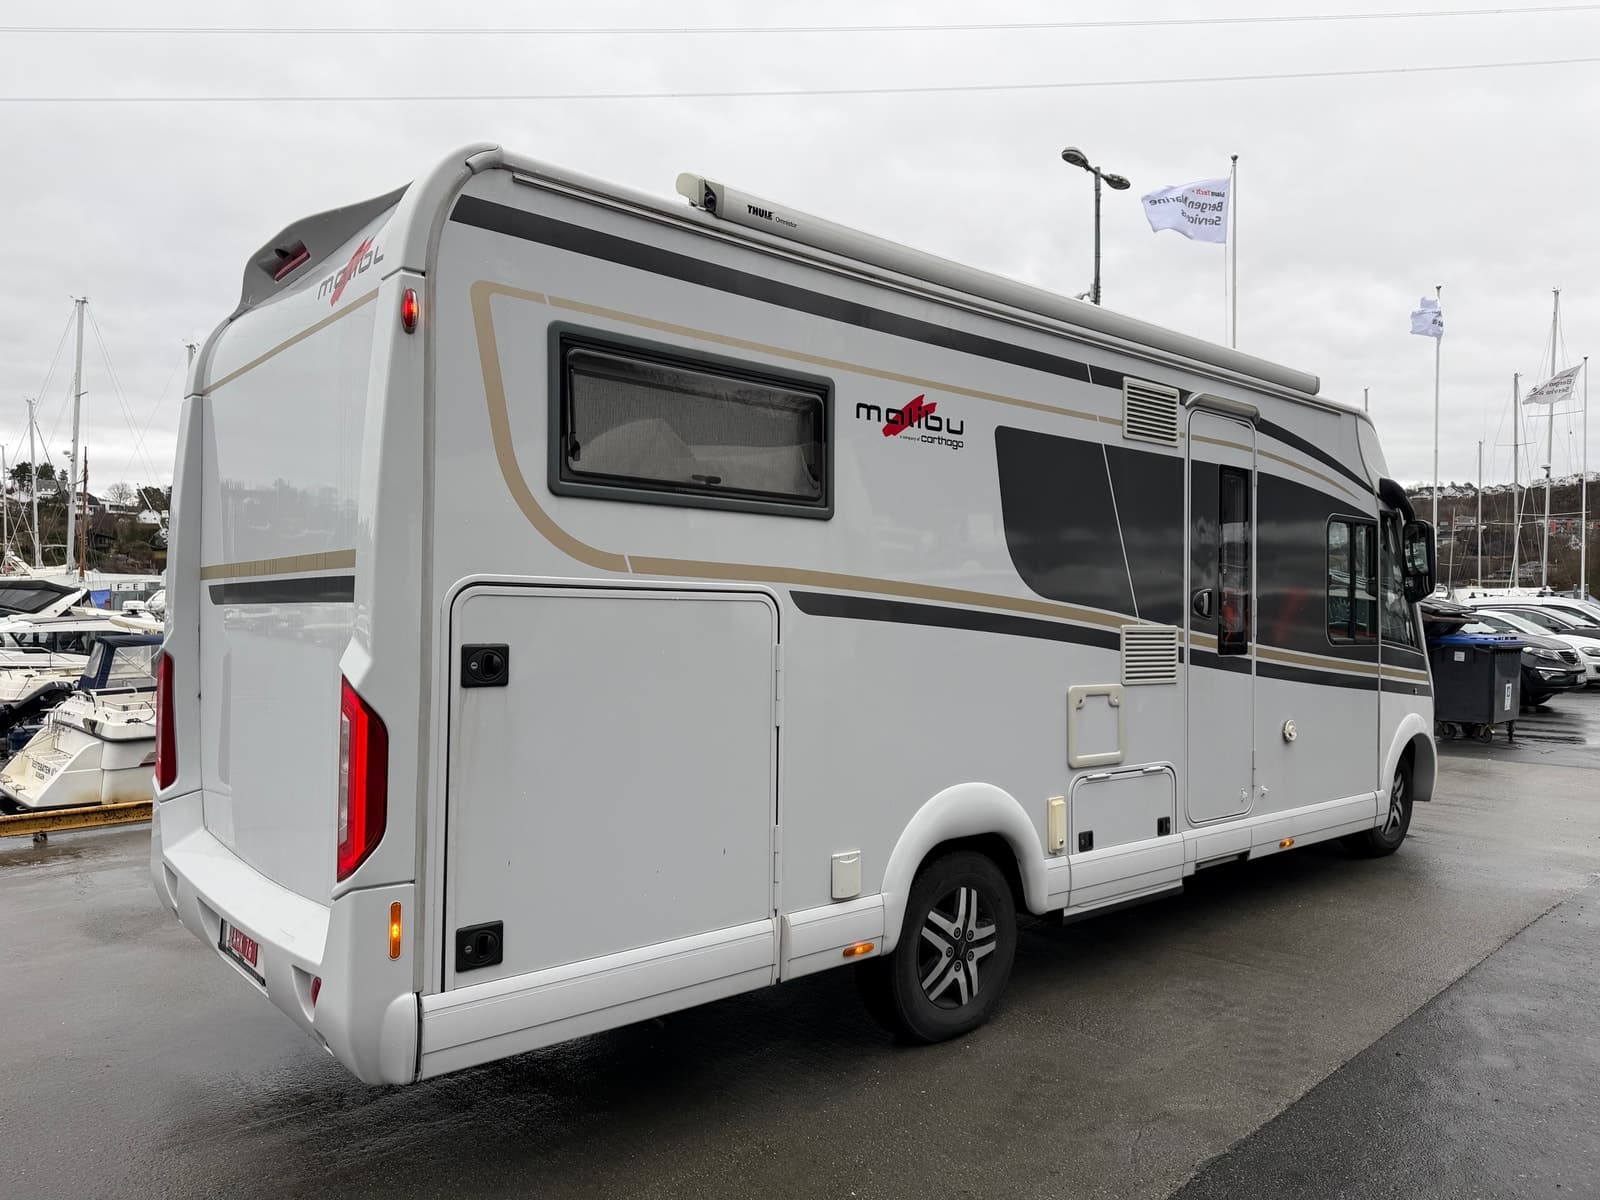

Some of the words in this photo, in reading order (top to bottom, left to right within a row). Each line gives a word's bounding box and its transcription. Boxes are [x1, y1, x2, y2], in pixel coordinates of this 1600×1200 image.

[747, 205, 774, 221] THULE
[856, 402, 964, 435] malibu
[921, 434, 964, 450] carthago
